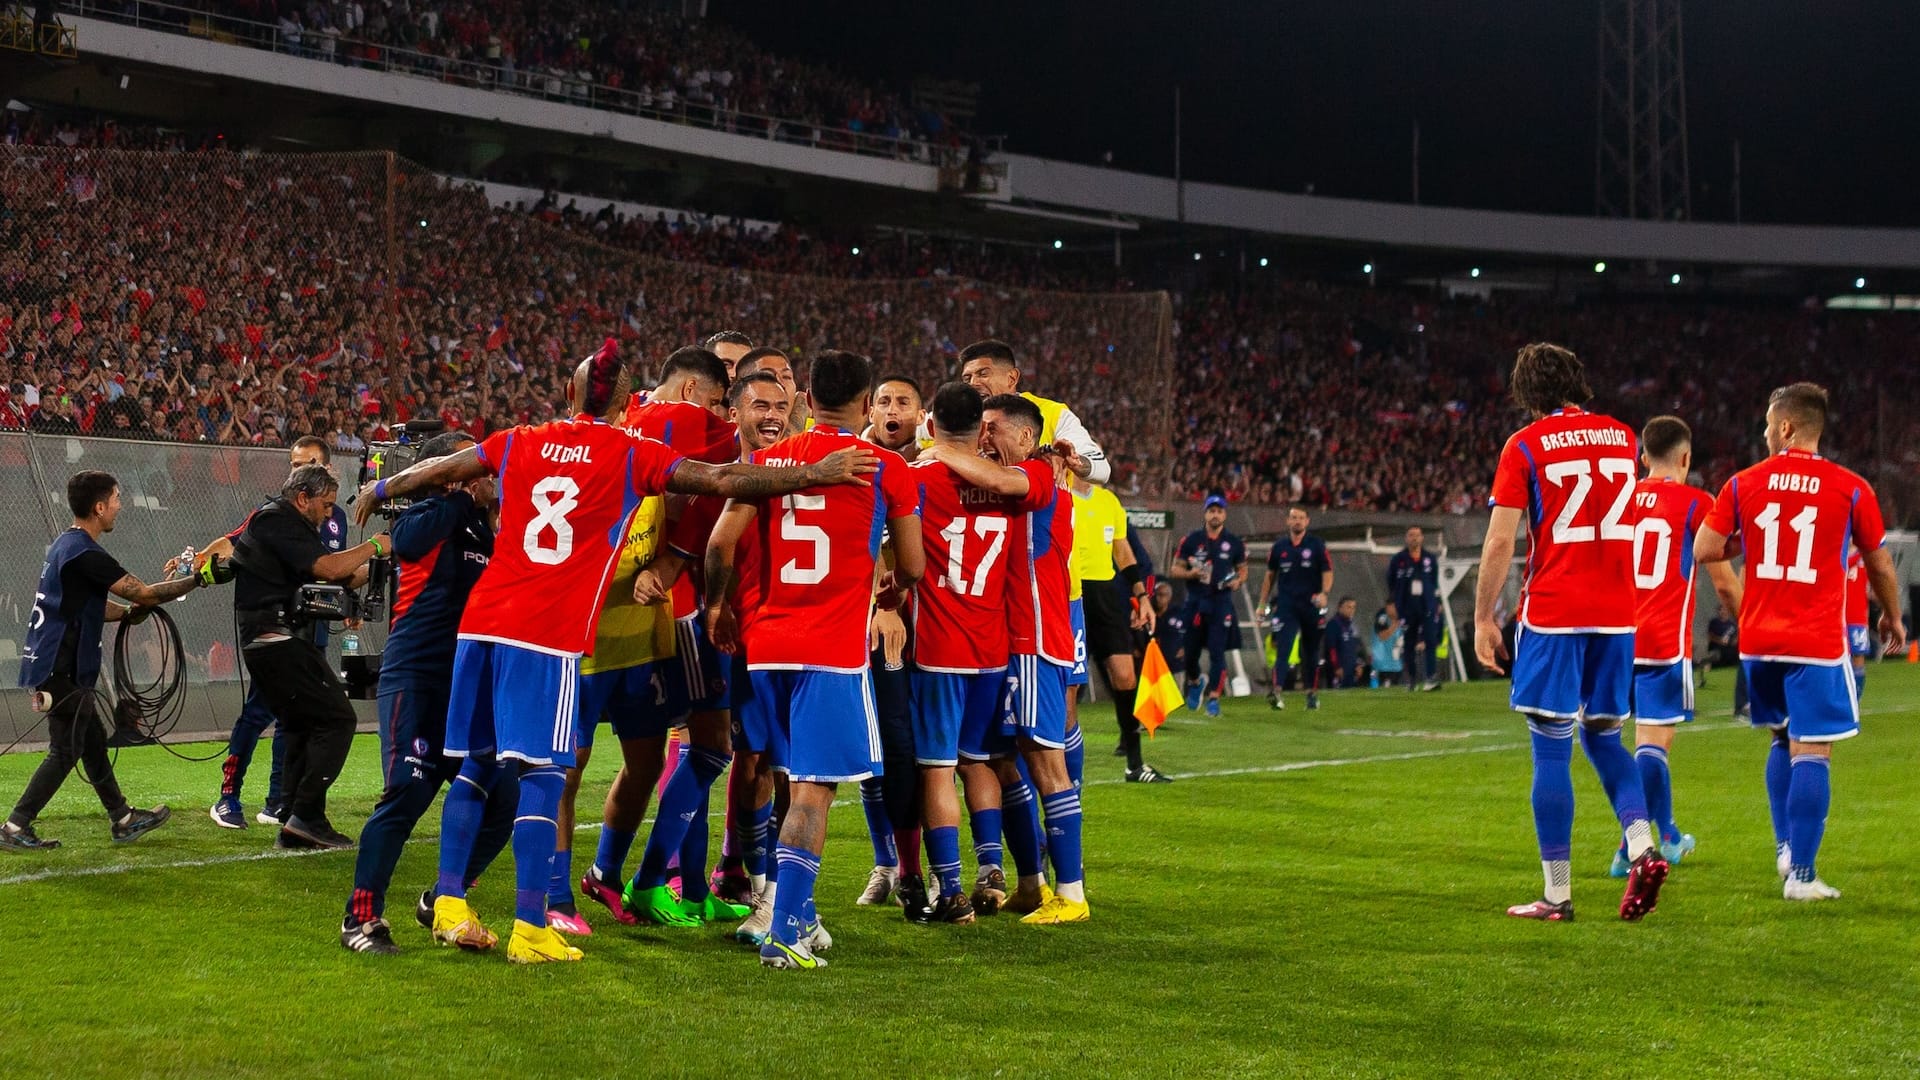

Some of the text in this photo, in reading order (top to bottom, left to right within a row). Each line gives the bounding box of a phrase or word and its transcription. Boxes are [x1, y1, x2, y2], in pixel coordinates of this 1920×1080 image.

[541, 442, 592, 463] VIDAL
[1540, 427, 1629, 452] BRERETONDÍAZ
[523, 476, 580, 565] 8
[1545, 457, 1636, 545] 22
[1767, 473, 1821, 495] RUBIO
[780, 493, 830, 585] 5
[939, 515, 1008, 597] 17
[1754, 502, 1818, 585] 11
